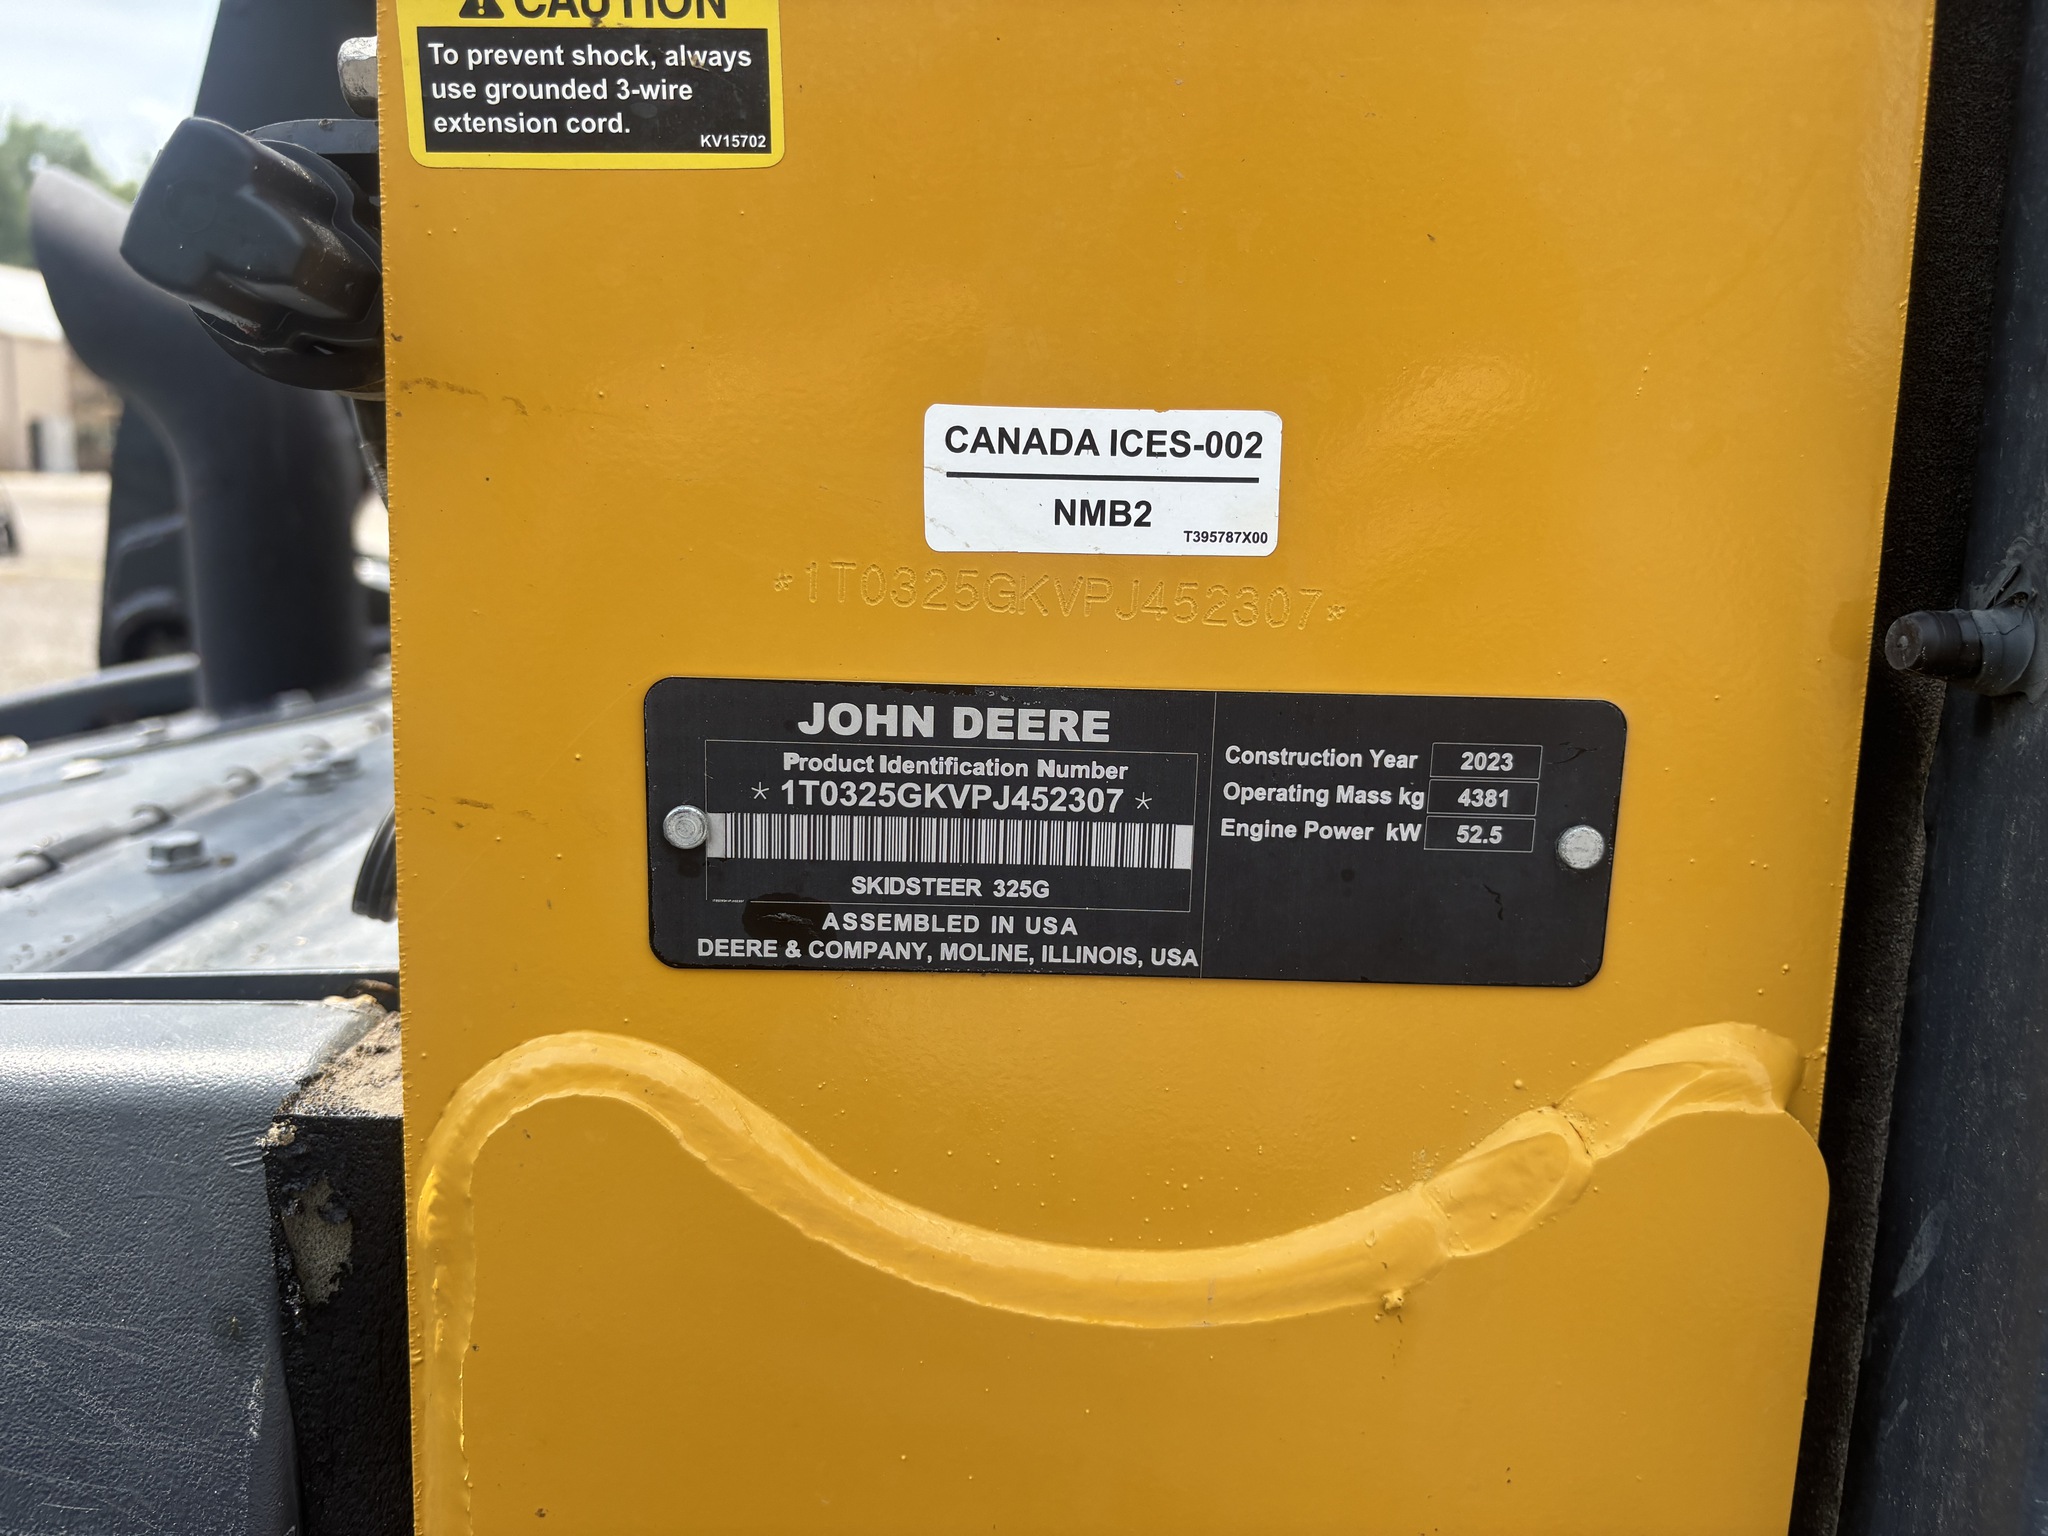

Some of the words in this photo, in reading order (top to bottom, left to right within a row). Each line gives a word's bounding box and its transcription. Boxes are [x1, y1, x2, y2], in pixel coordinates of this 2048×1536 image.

[427, 42, 459, 65] To
[467, 44, 565, 71] prevent
[571, 43, 656, 70] shock,
[665, 44, 752, 73] always
[431, 82, 477, 100] use
[484, 77, 608, 105] grounded
[616, 78, 693, 101] 3-wire
[433, 111, 558, 134] extension
[566, 111, 631, 134] cord.
[700, 134, 766, 148] KV15702
[944, 425, 1101, 457] CANADA
[1110, 428, 1263, 459] ICES-002
[1054, 498, 1152, 528] NMB2
[1183, 530, 1268, 544] T395787X00
[797, 702, 935, 738] JOHN
[952, 706, 1111, 743] DEERE
[783, 751, 875, 774] Product
[879, 754, 1029, 778] Identification
[1036, 758, 1129, 780] Number
[1225, 745, 1363, 768] Construction
[1369, 749, 1419, 769] Year
[1460, 751, 1514, 772] 2023
[781, 780, 1124, 813] 1T0325GKVPJ452307
[1223, 781, 1330, 807] Operating
[1335, 784, 1392, 805] Mass
[1398, 786, 1425, 811] kg
[1457, 788, 1509, 808] 4381
[1220, 817, 1298, 842] Engine
[1303, 820, 1375, 841] Power
[1386, 822, 1422, 842] kW
[1456, 824, 1503, 845] 52.5
[851, 875, 983, 897] SKIDSTEER
[992, 879, 1050, 899] 325G
[821, 912, 980, 933] ASSEMBLED
[991, 915, 1014, 934] IN
[1025, 916, 1078, 936] USA
[697, 938, 778, 958] DEERE
[784, 939, 802, 959] &
[811, 940, 933, 964] COMPANY,
[940, 942, 1035, 966] MOLINE,
[1041, 944, 1143, 969] ILLINOIS,
[1151, 947, 1199, 967] USA
